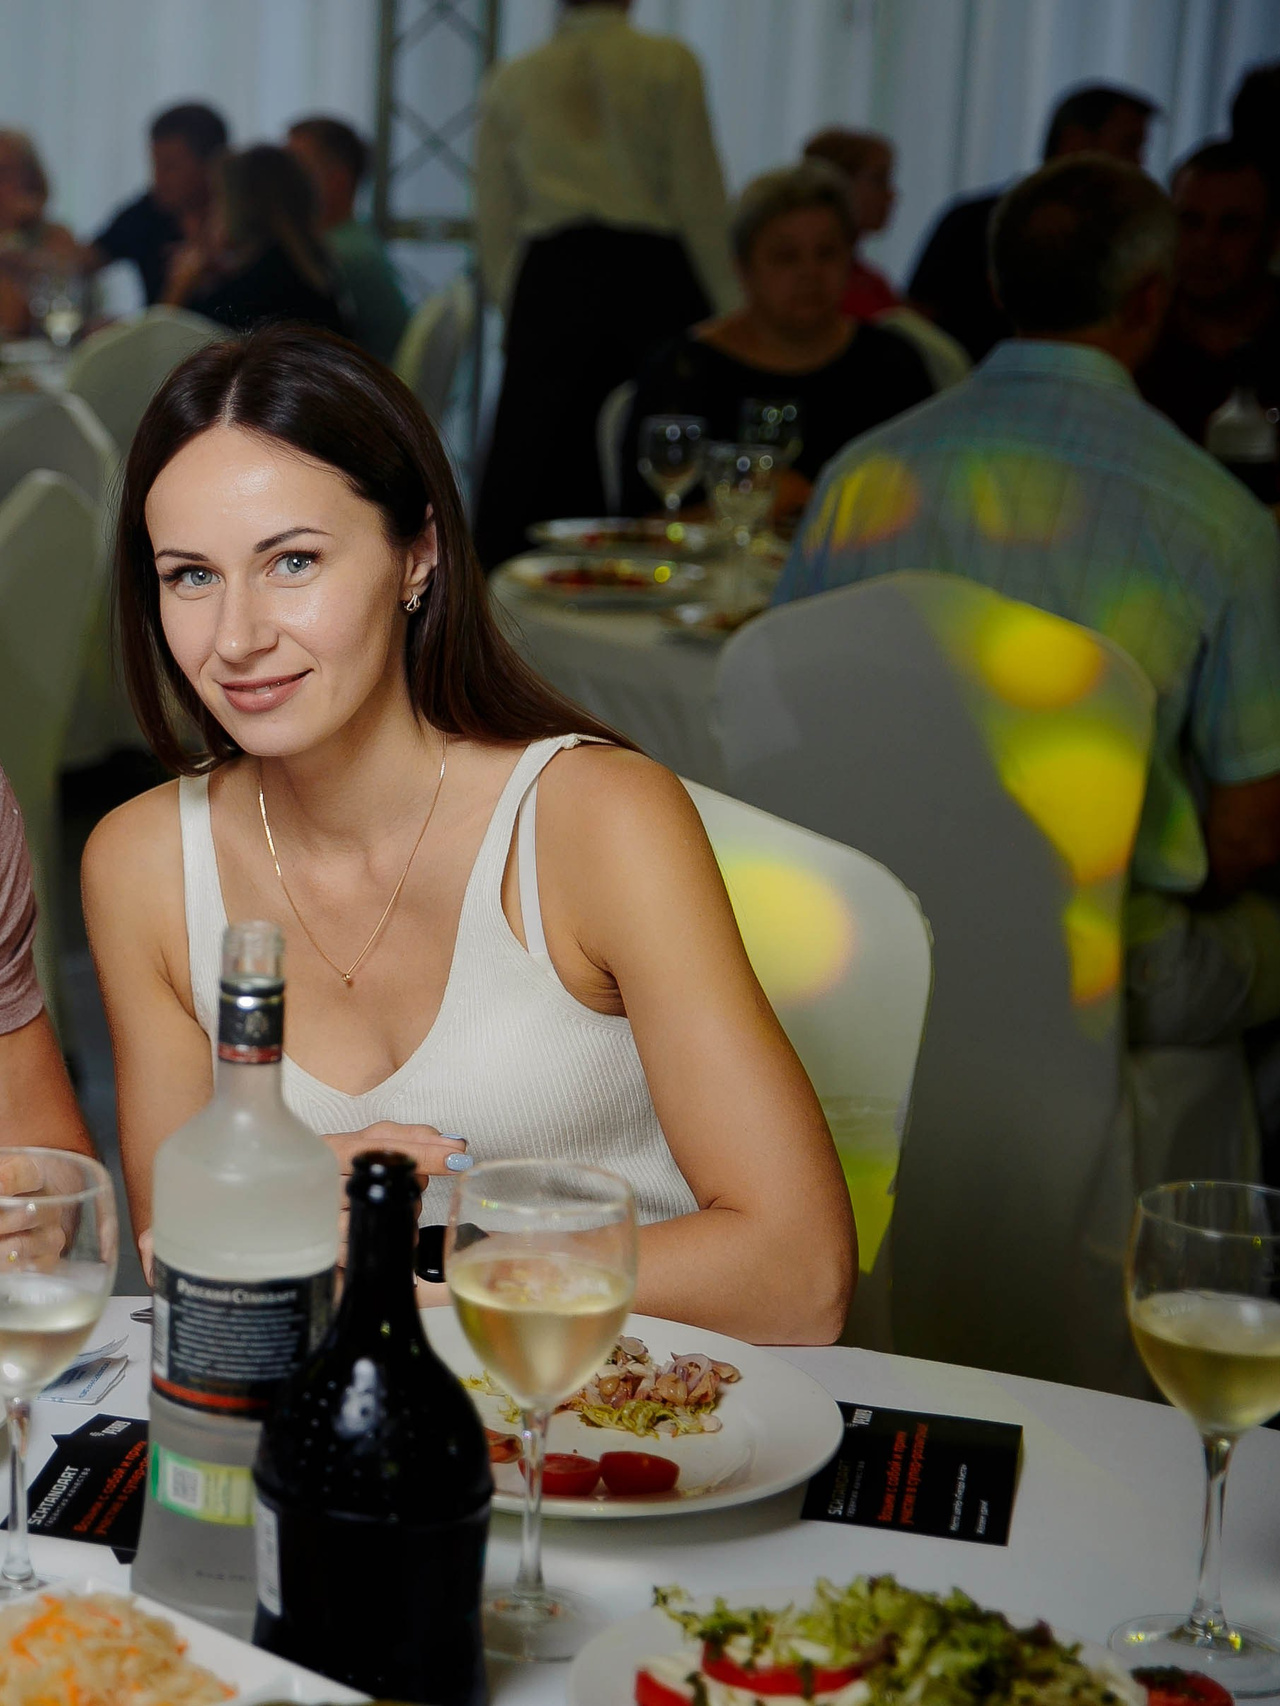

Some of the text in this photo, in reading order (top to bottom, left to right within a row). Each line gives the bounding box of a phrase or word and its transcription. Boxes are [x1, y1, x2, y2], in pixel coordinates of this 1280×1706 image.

[103, 1467, 127, 1493] собой
[886, 1459, 901, 1486] собой
[28, 1465, 79, 1525] SCHTANDART
